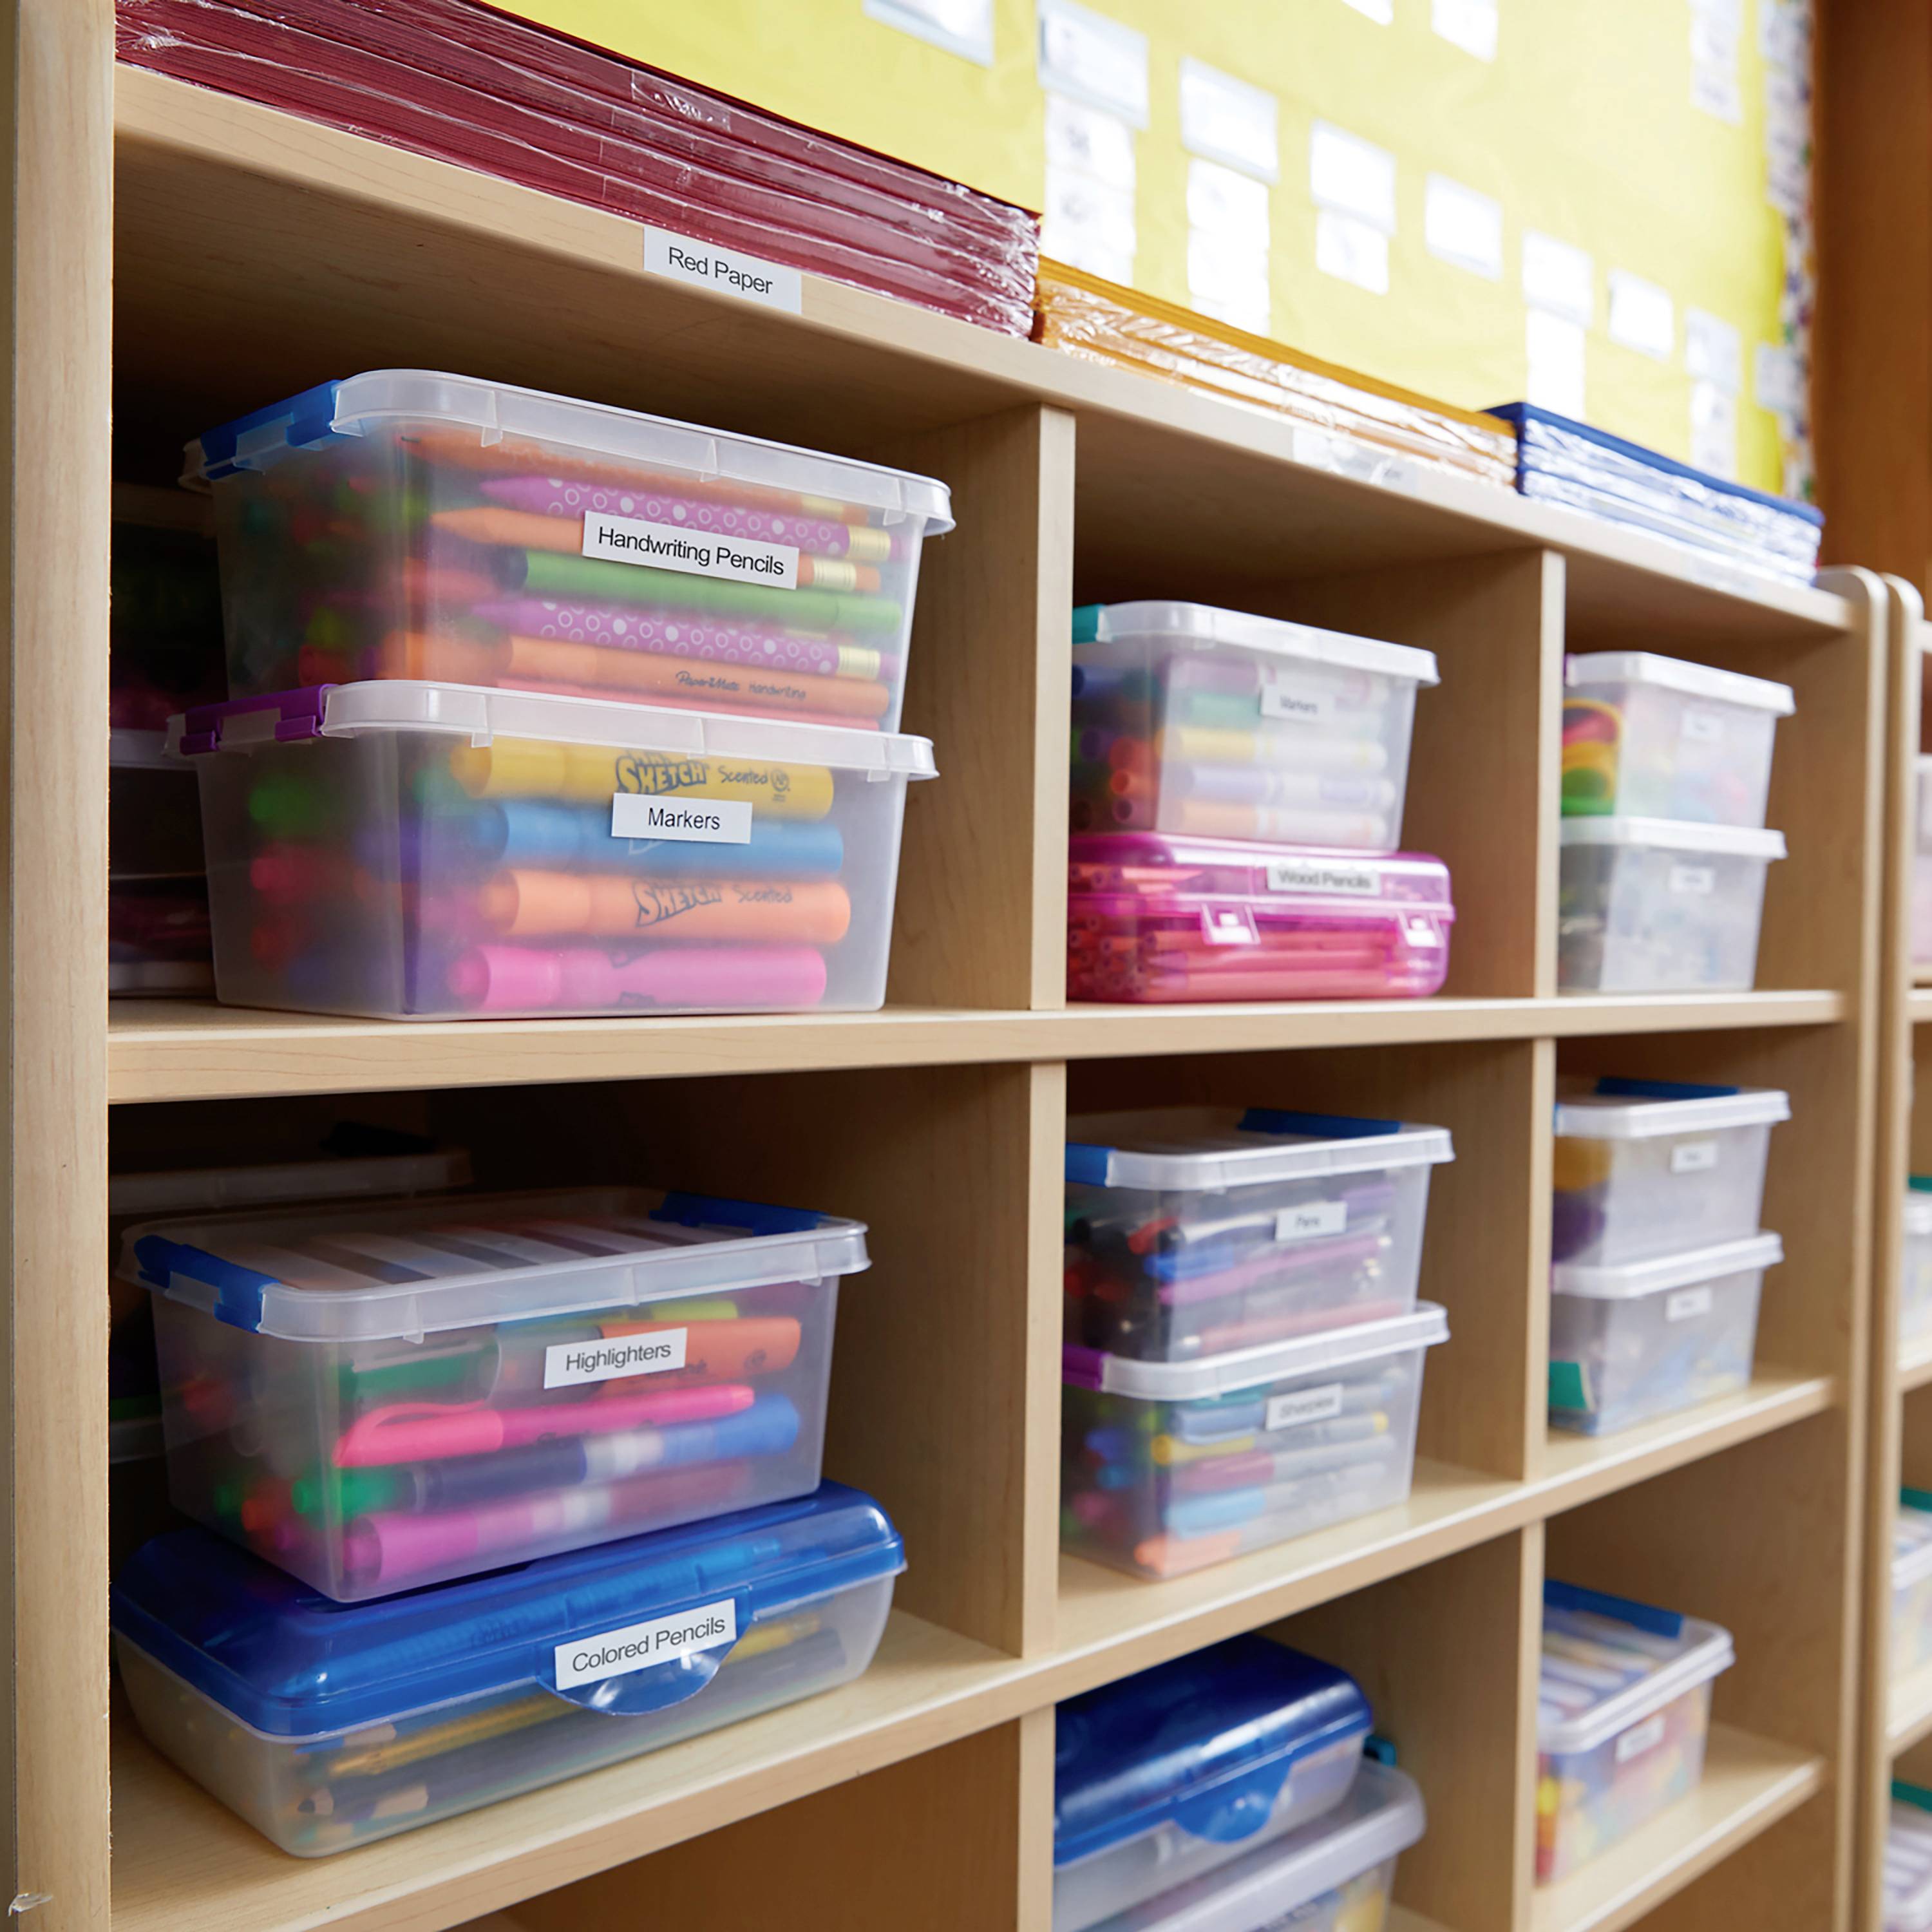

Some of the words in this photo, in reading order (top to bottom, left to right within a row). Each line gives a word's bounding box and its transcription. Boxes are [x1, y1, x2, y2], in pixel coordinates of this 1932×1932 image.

[669, 246, 708, 276] Red
[715, 260, 773, 293] Paper
[598, 526, 710, 567] Handwriting
[716, 546, 784, 575] Pencils
[616, 754, 707, 795] SKETCH
[717, 764, 768, 784] Scented
[648, 807, 720, 830] Markers
[732, 884, 793, 904] Scented
[1278, 869, 1318, 886] Wood
[1321, 871, 1371, 889] Pencils
[566, 1345, 671, 1373] Highlighters
[573, 1635, 649, 1672] Colored
[656, 1617, 725, 1650] Pencils
